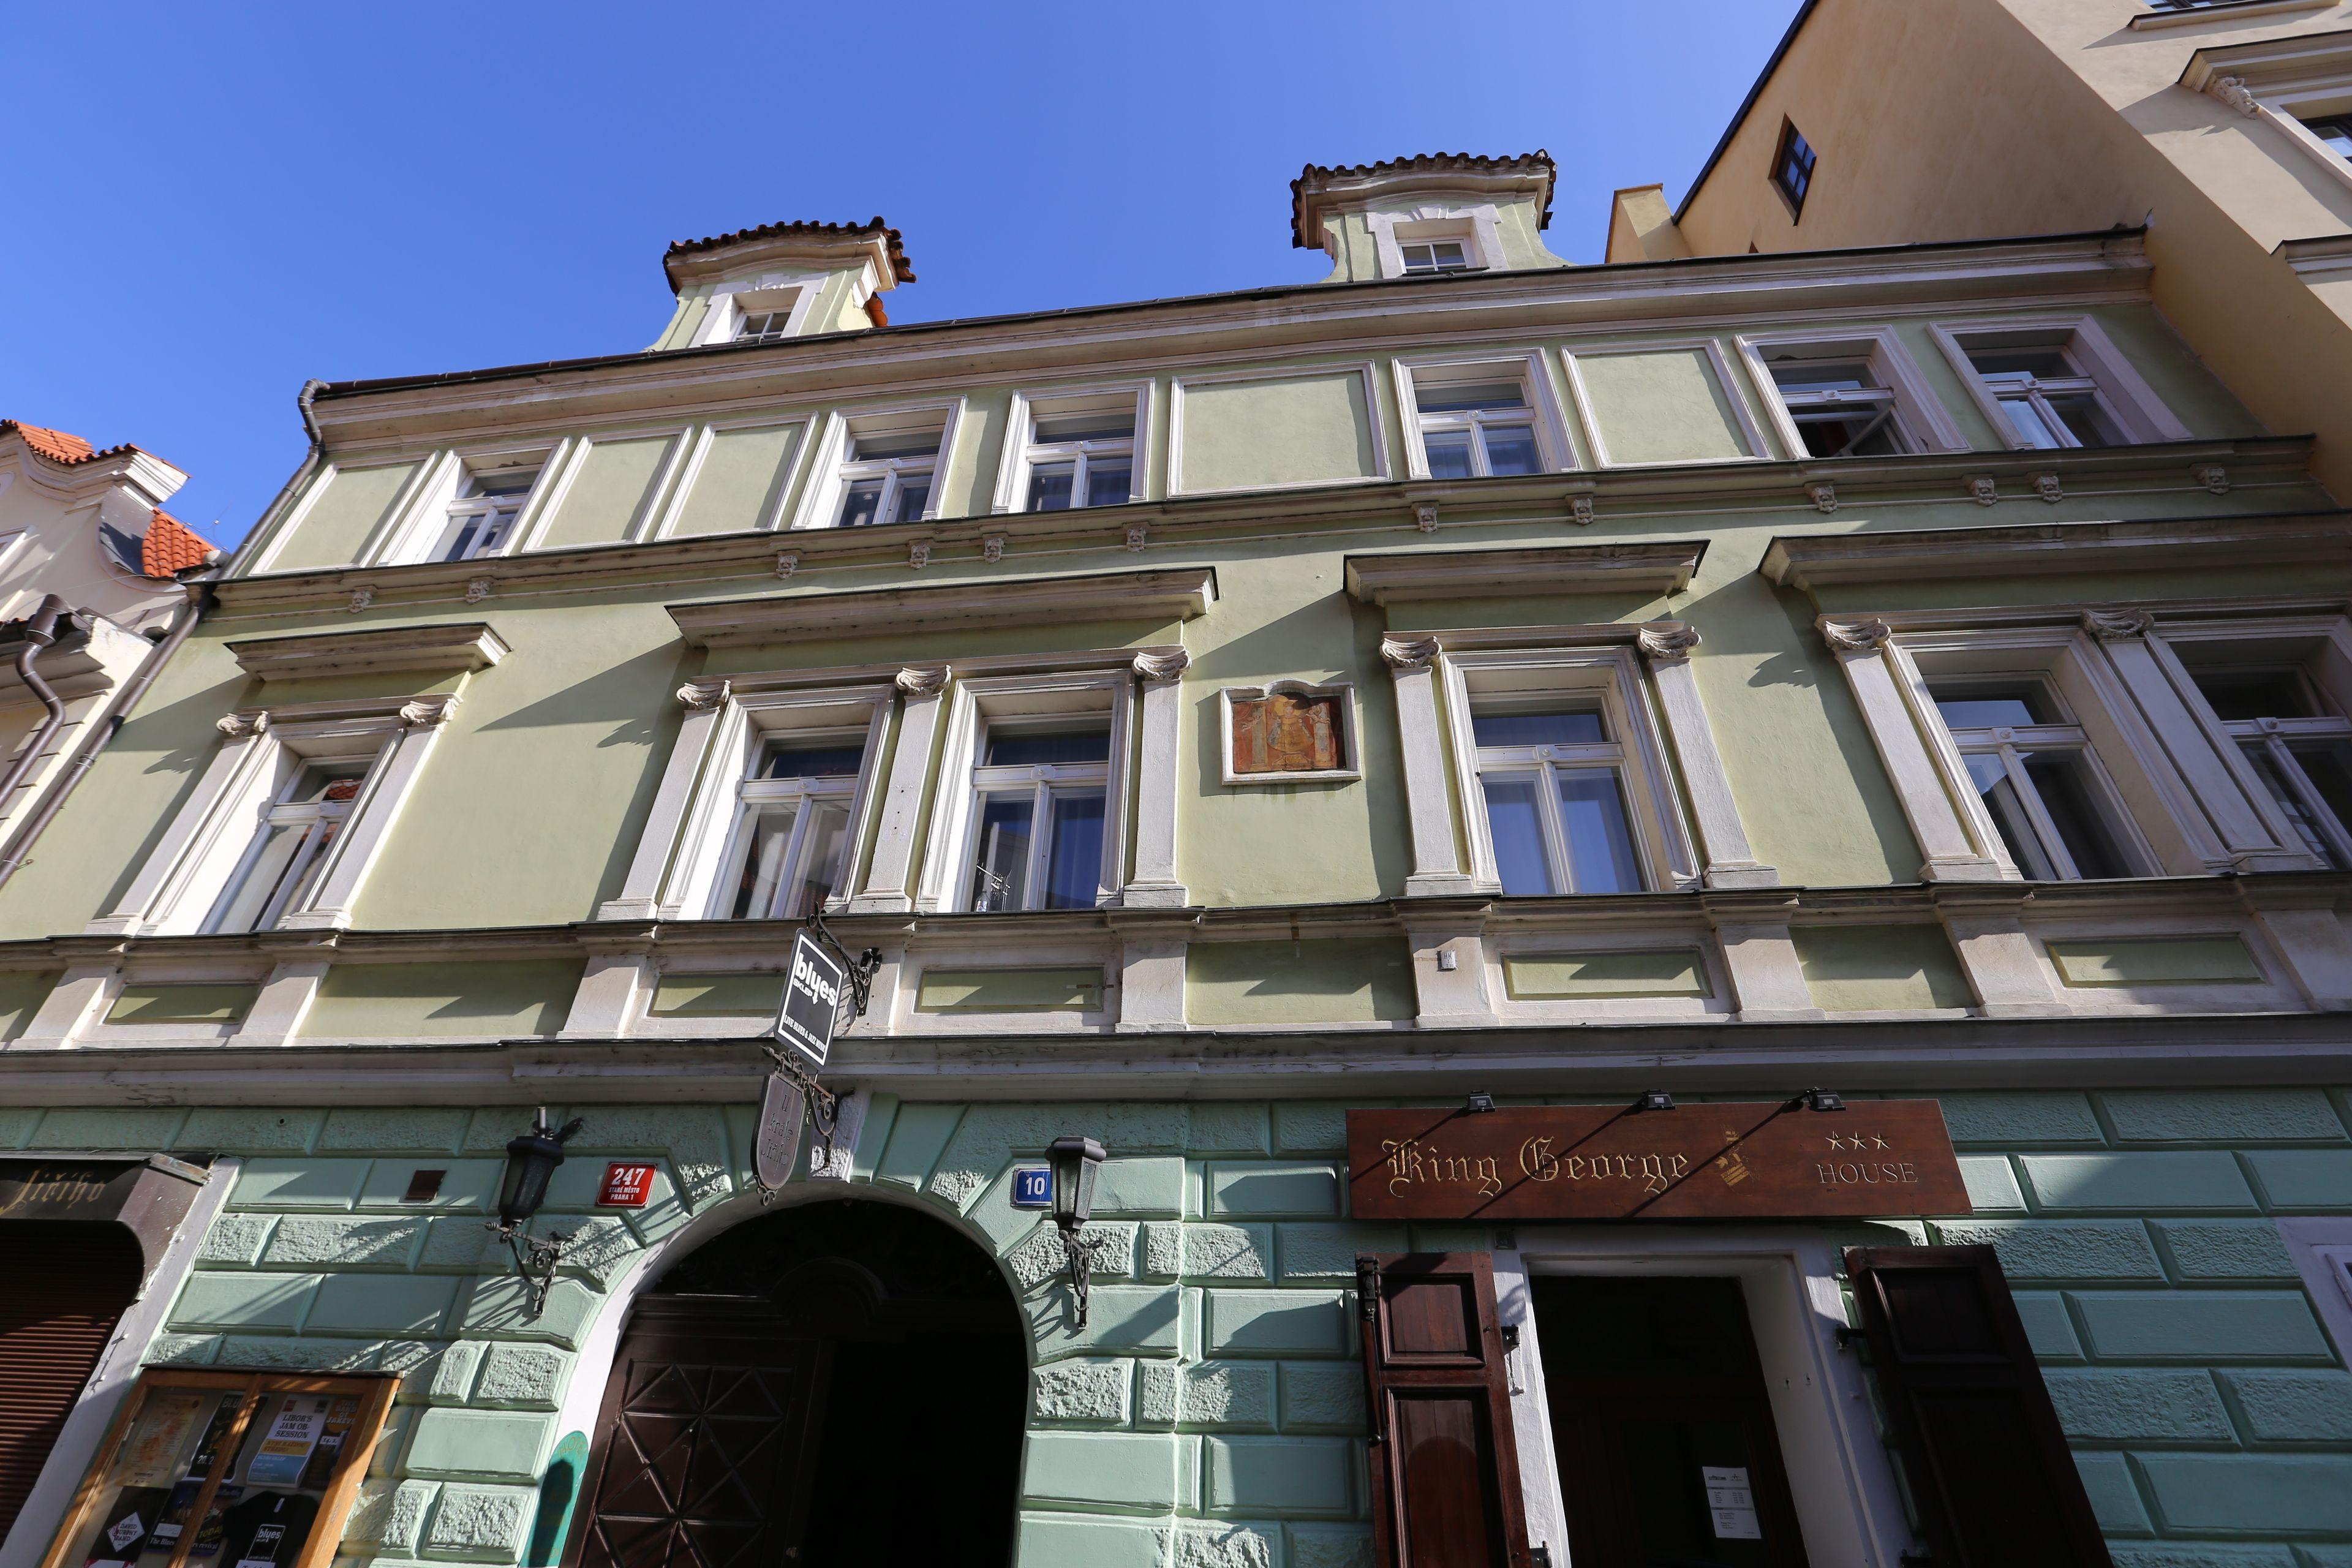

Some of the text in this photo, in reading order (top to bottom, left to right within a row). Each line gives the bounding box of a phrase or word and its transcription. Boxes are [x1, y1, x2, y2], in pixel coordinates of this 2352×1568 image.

[793, 978, 813, 998] SKLEP
[796, 952, 837, 1006] blues
[783, 1014, 794, 1028] LIVE
[793, 1019, 805, 1035] BLUES
[808, 1033, 816, 1044] JAZZ
[1381, 1134, 1691, 1197] King George
[1815, 1163, 1918, 1183] HOUSE
[611, 1167, 646, 1185] 247
[1026, 1177, 1046, 1195] 10
[275, 1430, 309, 1438] SESSION
